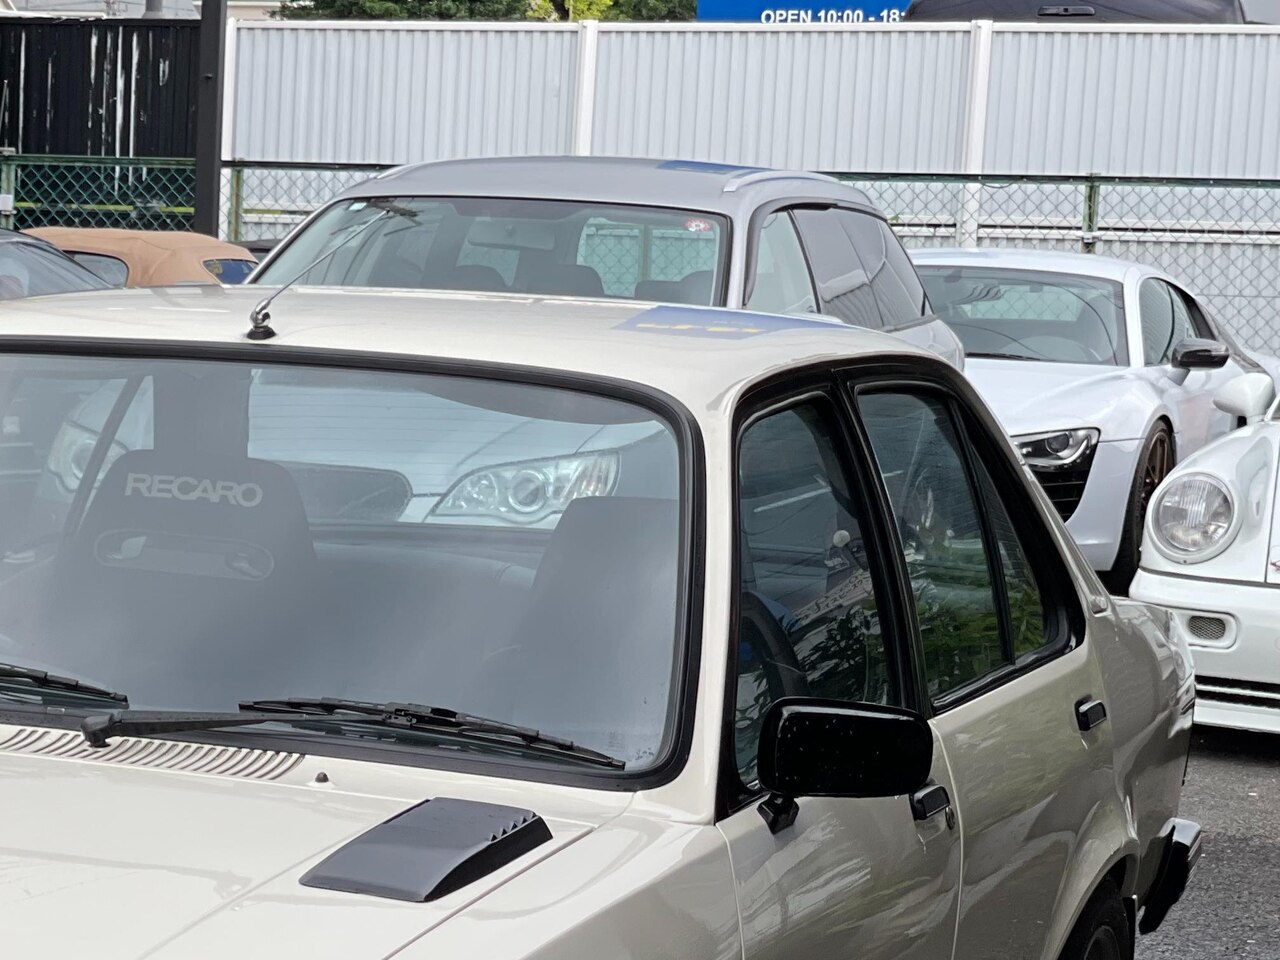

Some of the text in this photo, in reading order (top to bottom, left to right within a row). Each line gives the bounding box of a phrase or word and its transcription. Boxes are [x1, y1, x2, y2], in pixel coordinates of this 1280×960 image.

[760, 9, 812, 23] OPEN
[817, 9, 864, 23] 10:00
[124, 472, 264, 508] RECARO
